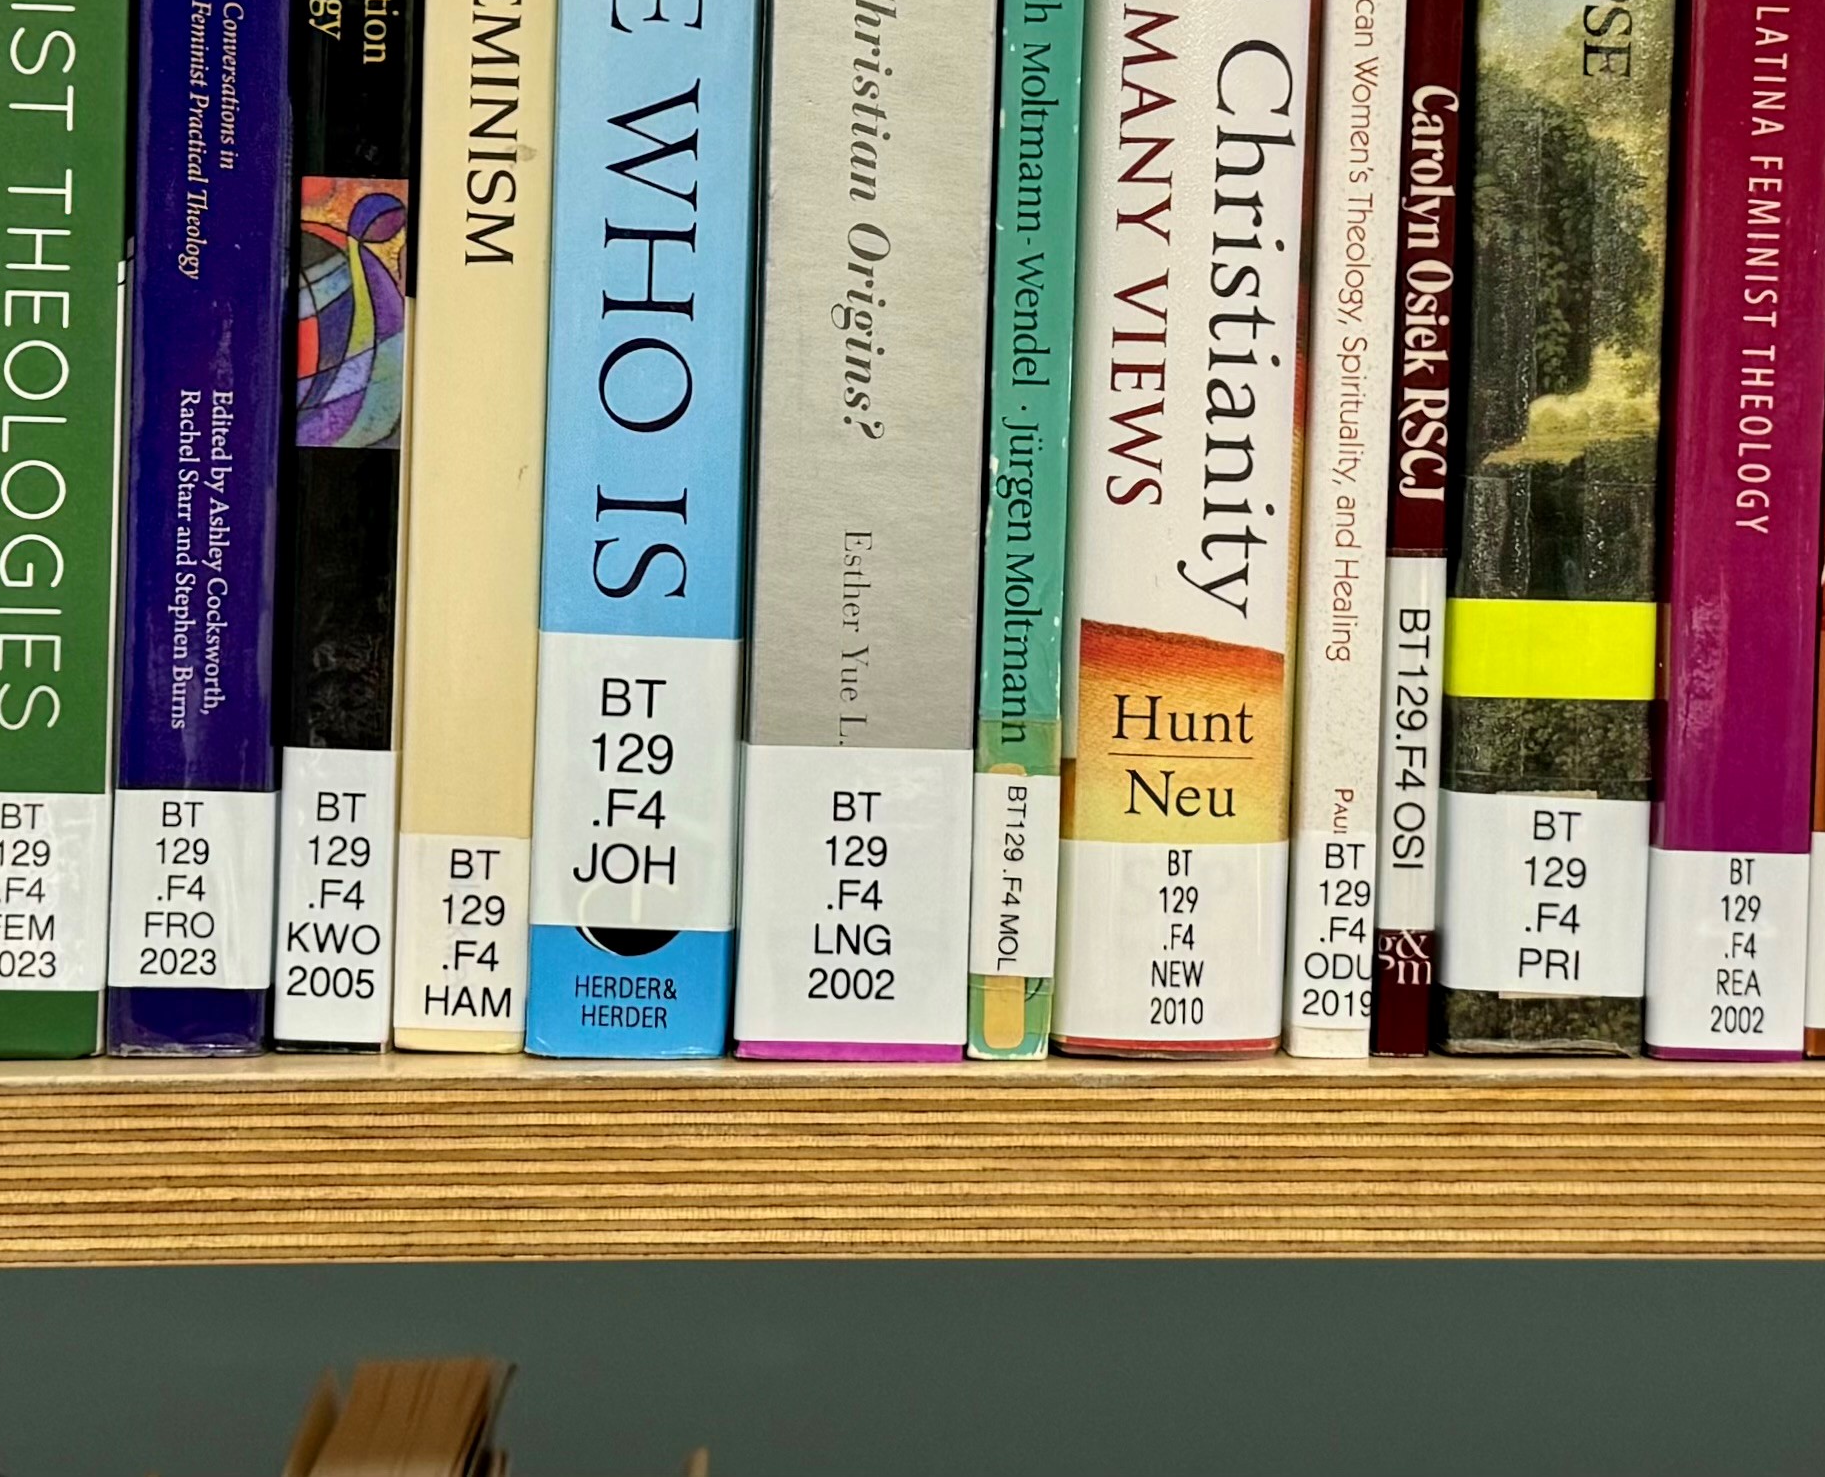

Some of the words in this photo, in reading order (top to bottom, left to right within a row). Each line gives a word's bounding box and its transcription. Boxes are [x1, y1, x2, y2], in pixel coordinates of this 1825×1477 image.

[1115, 7, 1180, 247] MANY
[597, 78, 702, 433] WHO
[832, 222, 893, 440] Origins?
[1176, 38, 1296, 618] Christianity
[1106, 267, 1169, 508] VIEWS
[592, 485, 687, 601] IS
[1113, 694, 1253, 742] Hunt
[317, 793, 366, 822] BT
[1124, 769, 1236, 818] Neu
[309, 836, 370, 866] 129
[310, 880, 364, 910] .F4
[288, 924, 380, 954] KWO
[287, 966, 375, 998] 2005
[581, 1005, 668, 1029] HERDER
